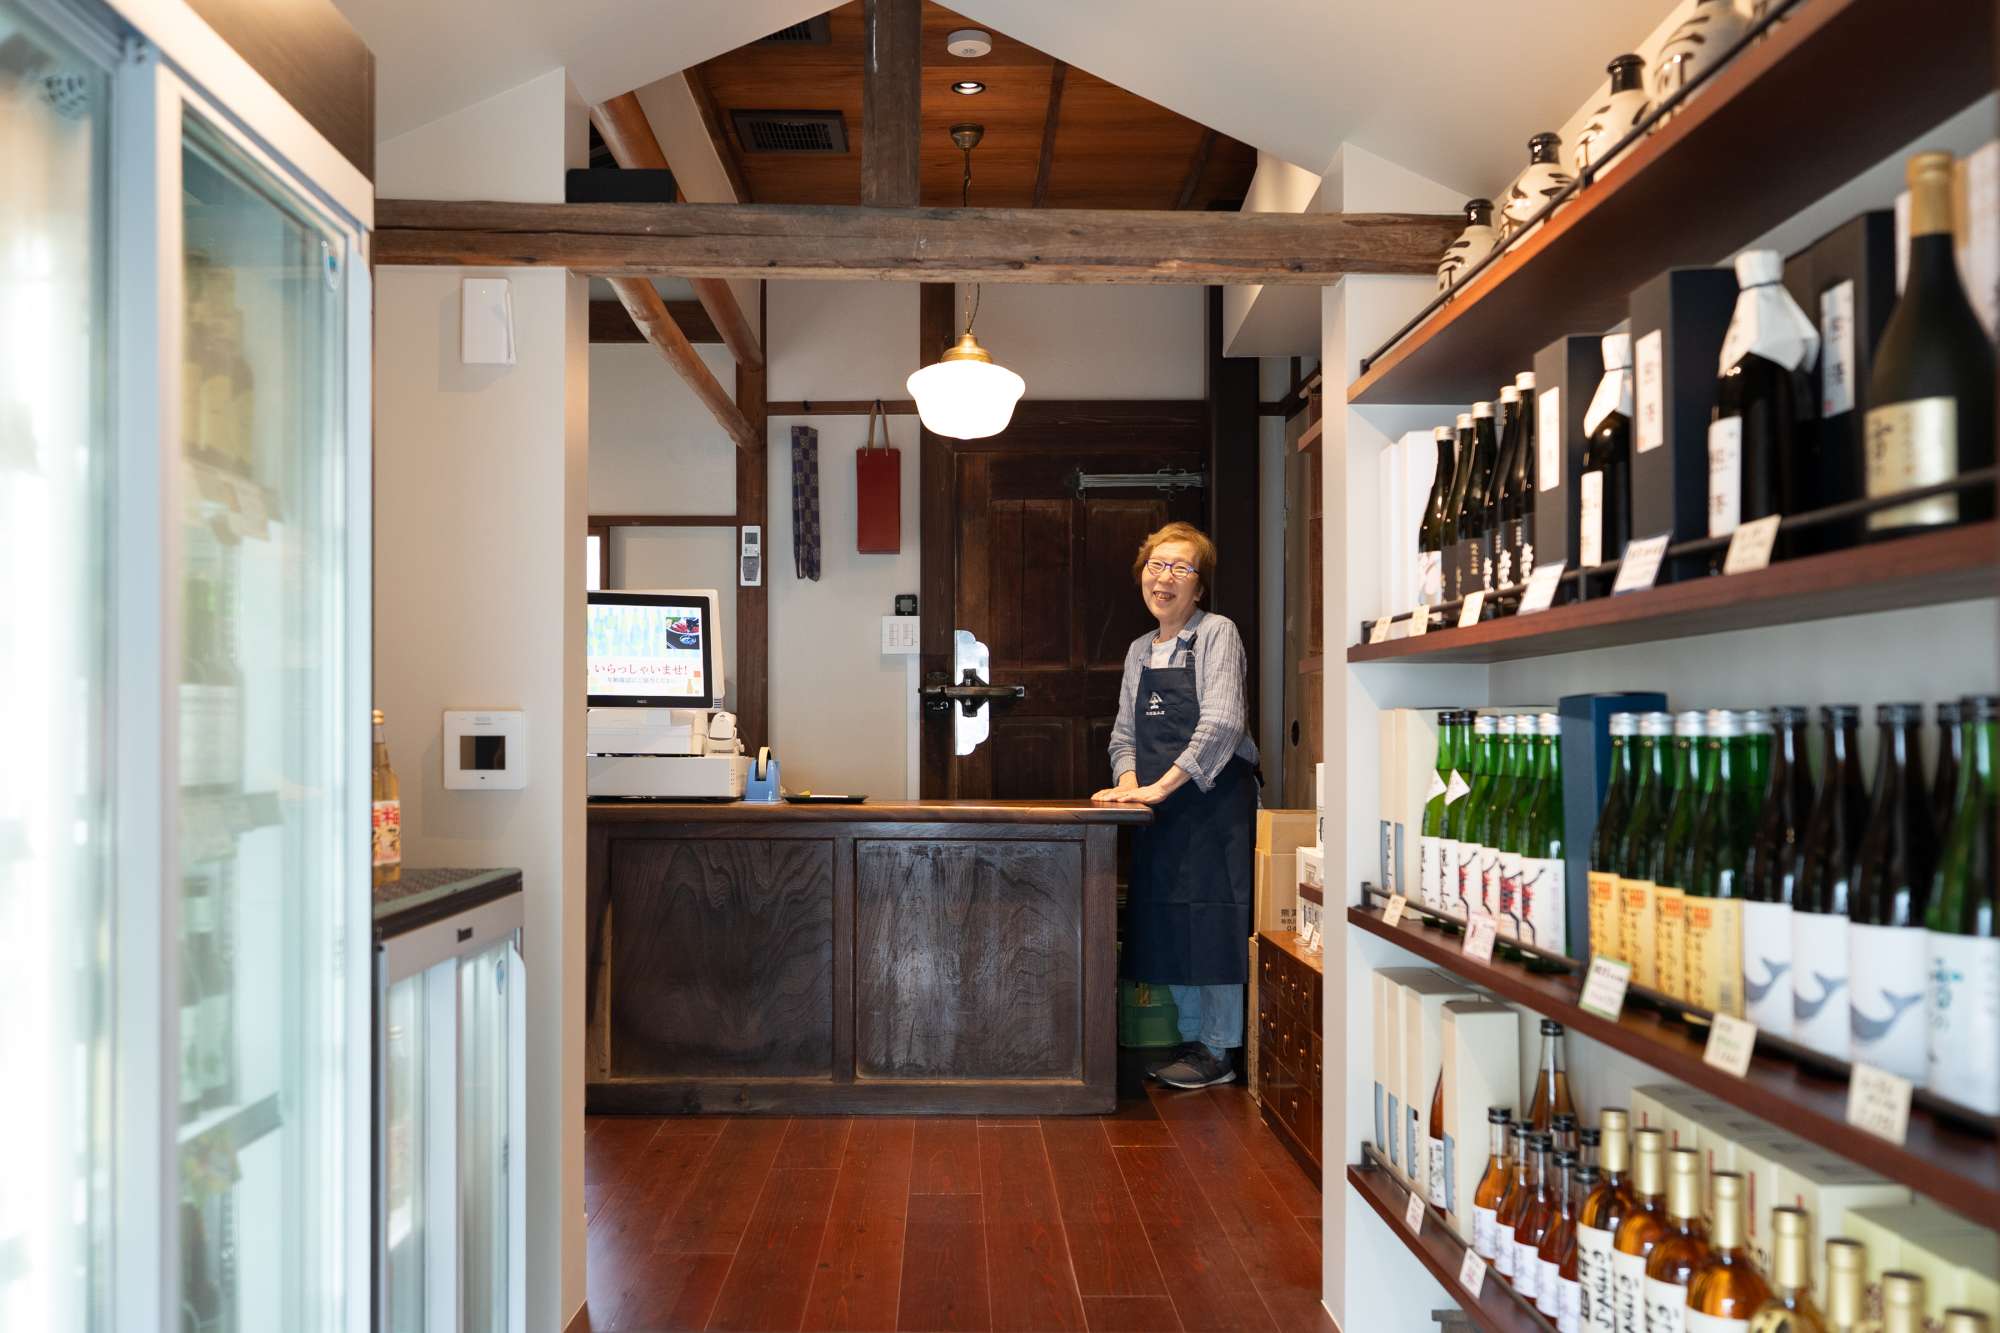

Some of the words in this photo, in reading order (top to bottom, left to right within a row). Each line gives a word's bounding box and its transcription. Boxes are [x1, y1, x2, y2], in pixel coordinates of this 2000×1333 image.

[594, 664, 688, 675] いらっしゃいませ!
